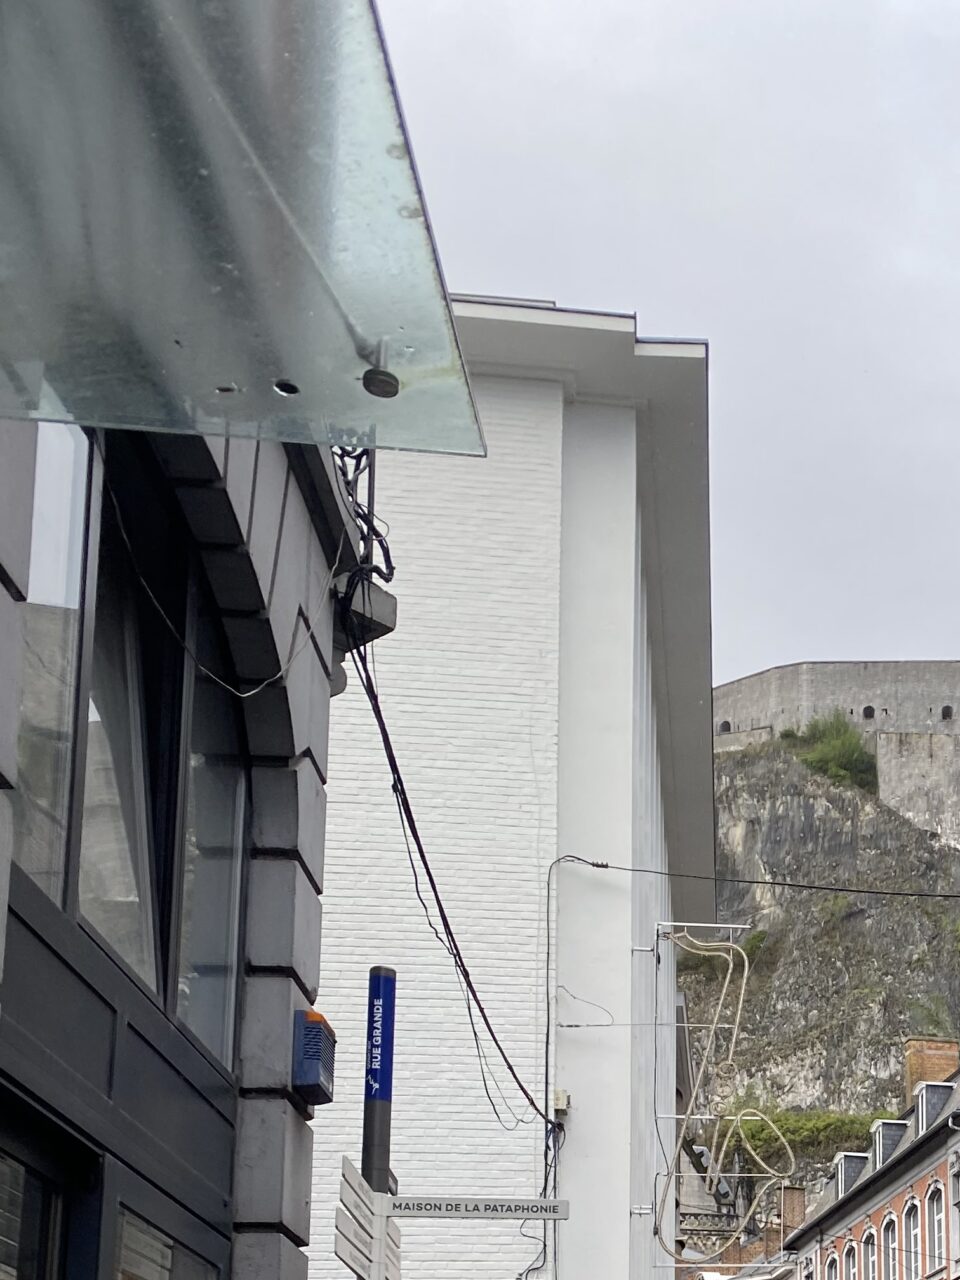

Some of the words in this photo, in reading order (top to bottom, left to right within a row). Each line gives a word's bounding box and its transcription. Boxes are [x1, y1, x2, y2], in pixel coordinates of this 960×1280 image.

[372, 998, 383, 1044] GRANDE
[371, 1047, 382, 1069] RUE
[392, 1202, 442, 1212] MAISON
[445, 1203, 461, 1212] DE
[464, 1203, 481, 1213] LA
[483, 1204, 559, 1214] PATAPHONIE
